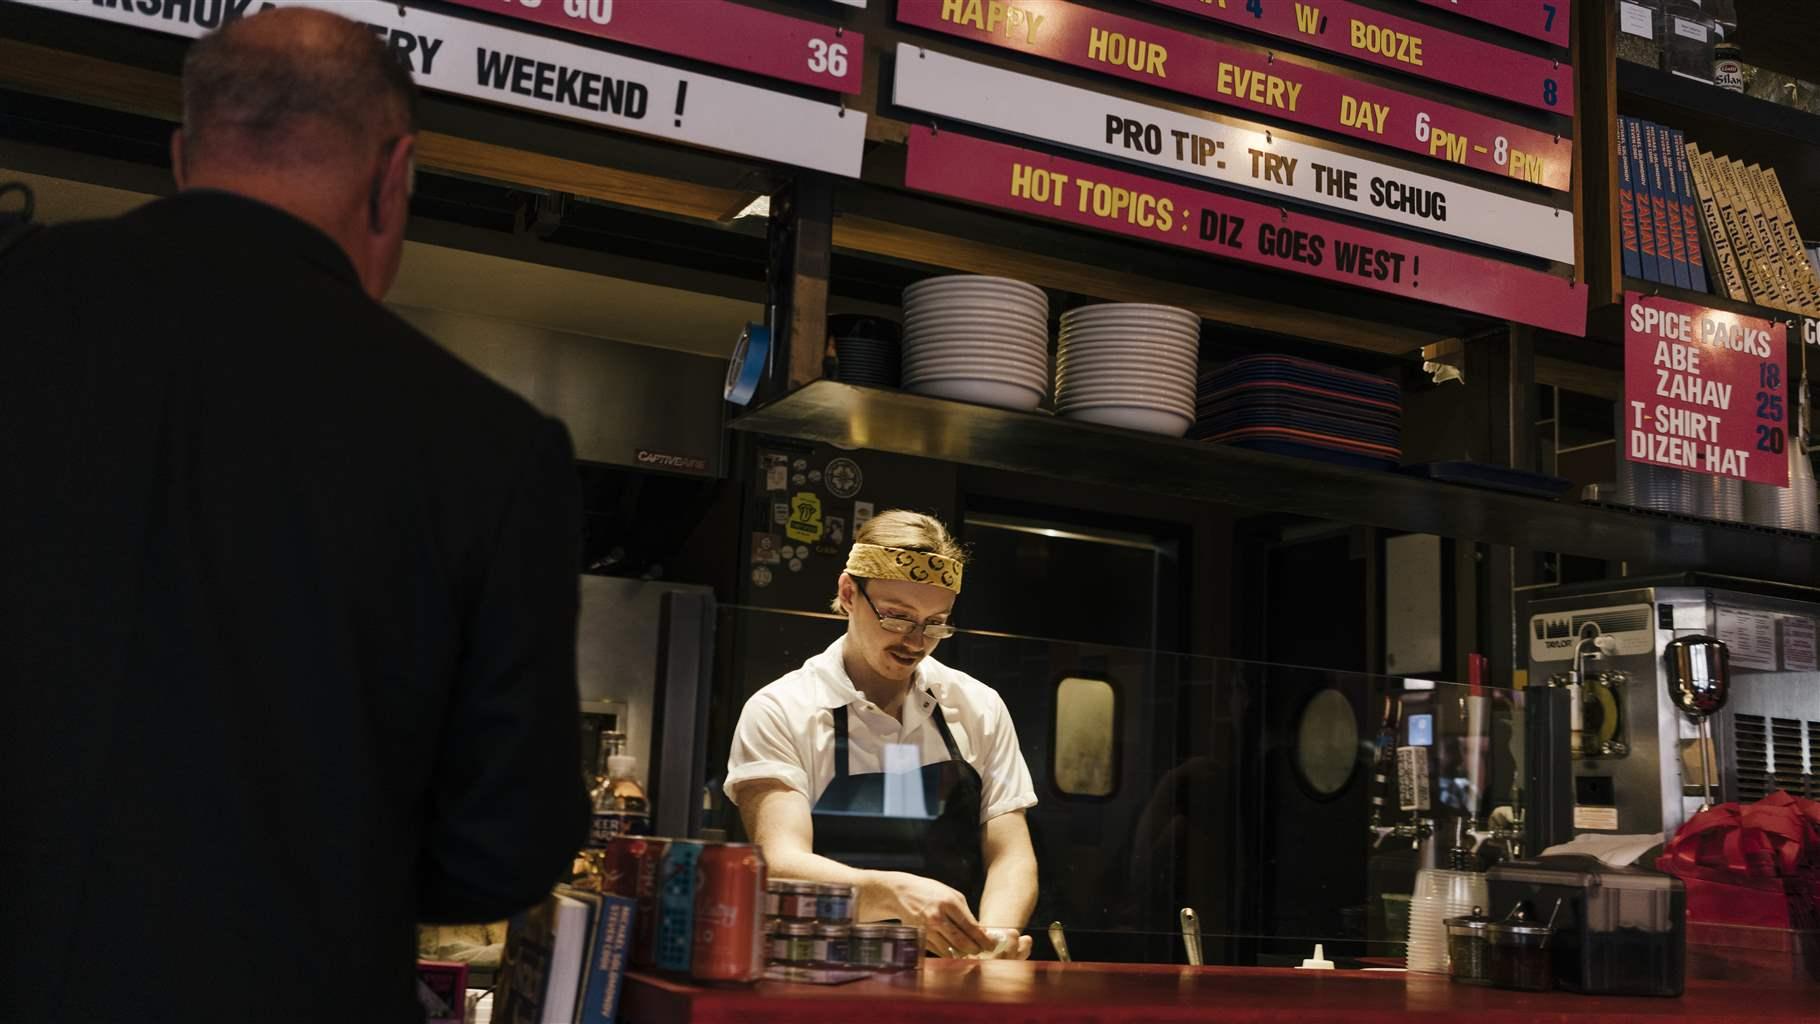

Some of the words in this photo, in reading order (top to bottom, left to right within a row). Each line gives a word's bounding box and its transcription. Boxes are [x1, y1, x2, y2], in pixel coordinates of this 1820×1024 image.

[1543, 4, 1556, 32] 7
[476, 47, 648, 120] WEEKEND
[674, 80, 688, 128] !
[807, 38, 848, 77] 36
[941, 0, 1045, 45] HAPPY
[1088, 27, 1168, 78] HOUR
[1217, 62, 1303, 112] EVERY
[1340, 95, 1391, 135] DAY
[1350, 19, 1424, 66] BOOZE
[1543, 79, 1558, 106] 8
[1715, 73, 1742, 86] Silan
[1105, 114, 1162, 155] PRO
[1171, 130, 1227, 170] TIP:
[1248, 148, 1298, 187] TRY
[1311, 162, 1358, 201] THE
[1370, 176, 1448, 222] SCHUG
[1011, 163, 1068, 207] HOT
[1200, 208, 1242, 249] DIZ
[1258, 222, 1324, 267] GOES
[1619, 189, 1637, 251] ZAHAV
[1636, 192, 1655, 256] ZAHAV
[1652, 196, 1671, 259] ZAHAV
[1667, 200, 1686, 263] ZAHAV
[1682, 204, 1702, 267] ZAHAV
[1703, 197, 1728, 250] Israeli
[1719, 252, 1742, 292] Soul
[1737, 208, 1764, 260] Israeli
[1753, 213, 1781, 264] Israeli
[1721, 204, 1748, 256] Israeli
[1742, 258, 1766, 299] Soul
[1630, 304, 1692, 343] SPICE
[1701, 319, 1772, 358] PACKS
[1654, 340, 1700, 375] ABE
[1759, 361, 1781, 390] 18
[1656, 369, 1733, 410] ZAHAV
[1756, 391, 1783, 422] 25
[1756, 424, 1784, 454] 20
[1545, 640, 1572, 649] TAYLOR
